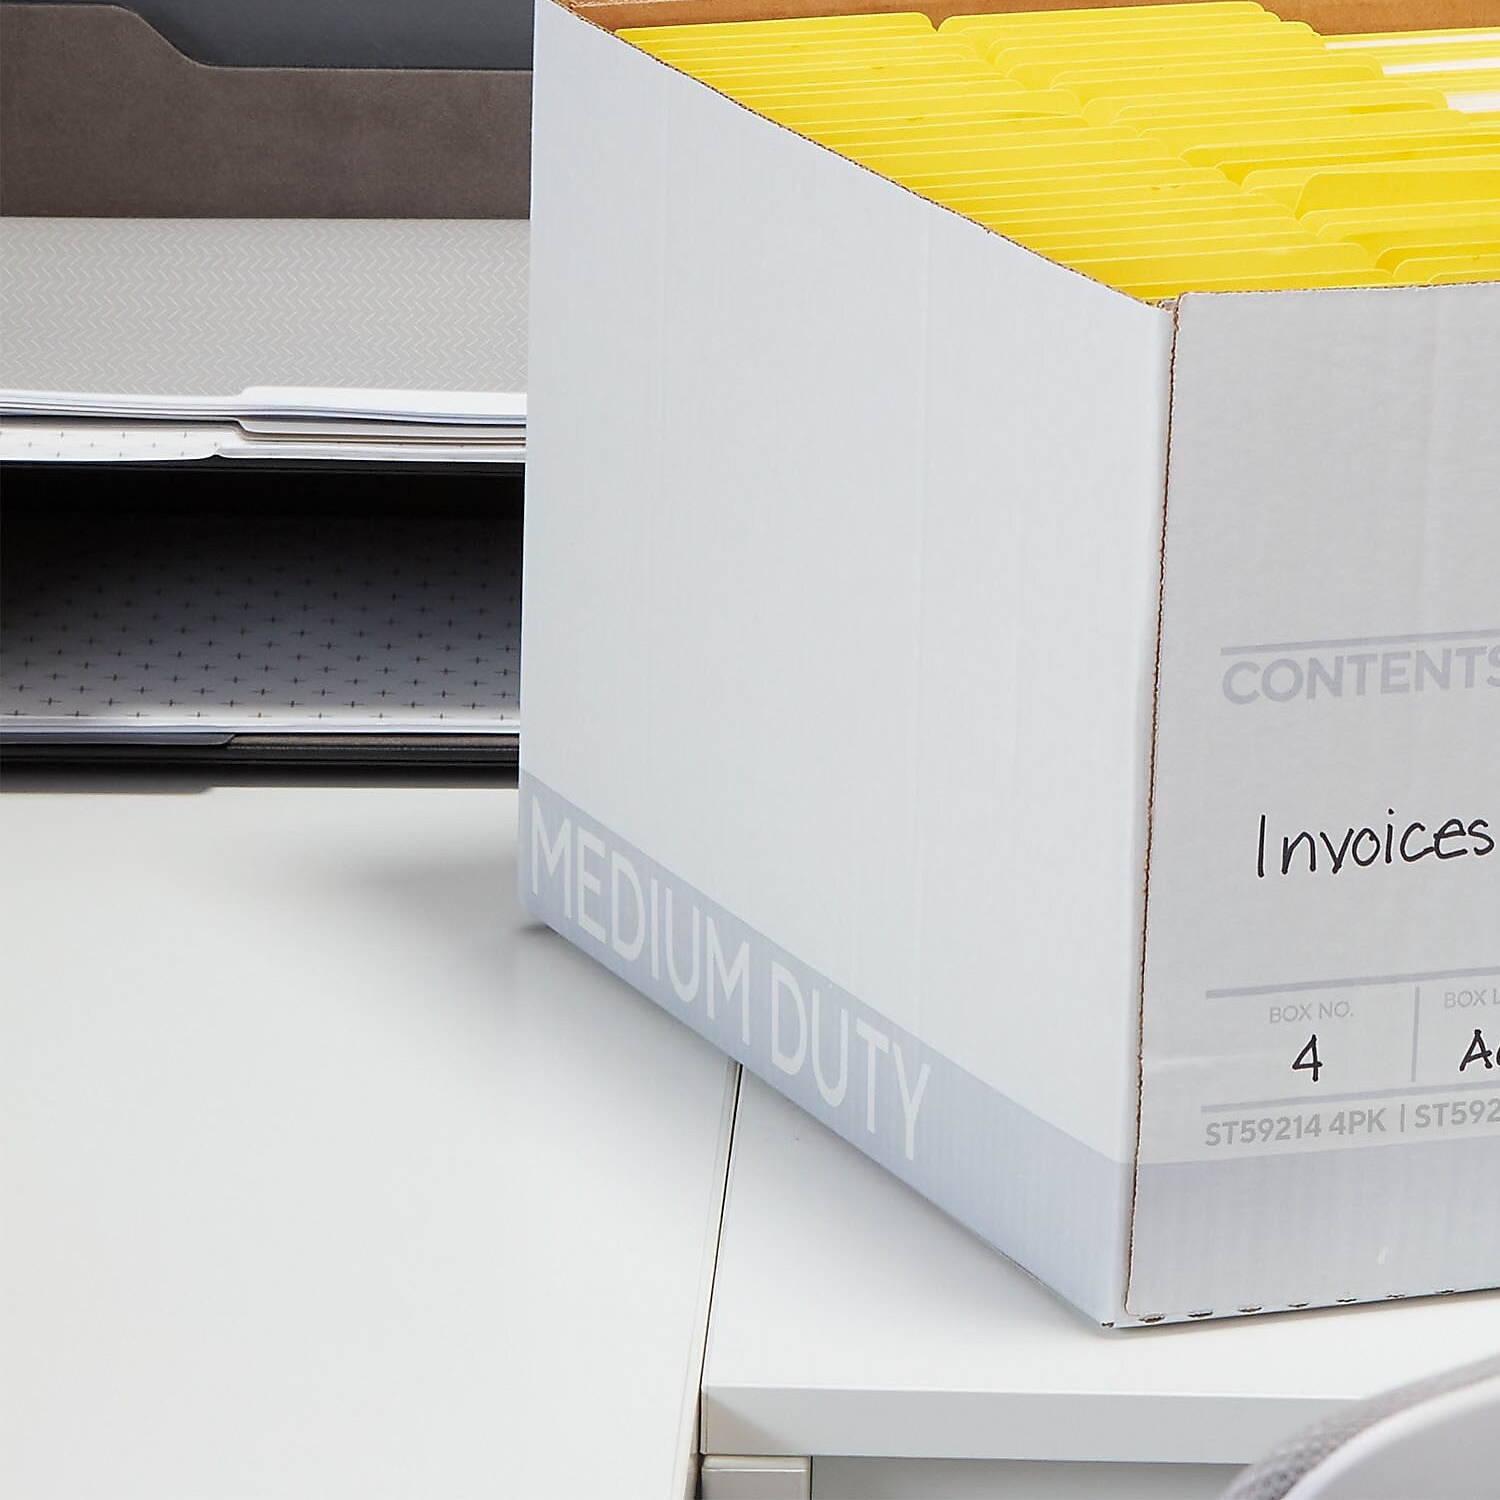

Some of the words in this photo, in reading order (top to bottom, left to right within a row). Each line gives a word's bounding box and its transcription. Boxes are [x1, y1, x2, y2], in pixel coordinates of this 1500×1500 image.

[1257, 808, 1495, 878] Invoices
[531, 795, 750, 1046] MEDIUM
[771, 961, 931, 1161] DUTY
[1444, 988, 1487, 1009] BOX
[1269, 1004, 1313, 1023] BOX
[1319, 1001, 1354, 1020] NO.
[1292, 1034, 1323, 1082] 4
[1205, 1114, 1321, 1146] ST59214
[1329, 1107, 1386, 1135] 4PK
